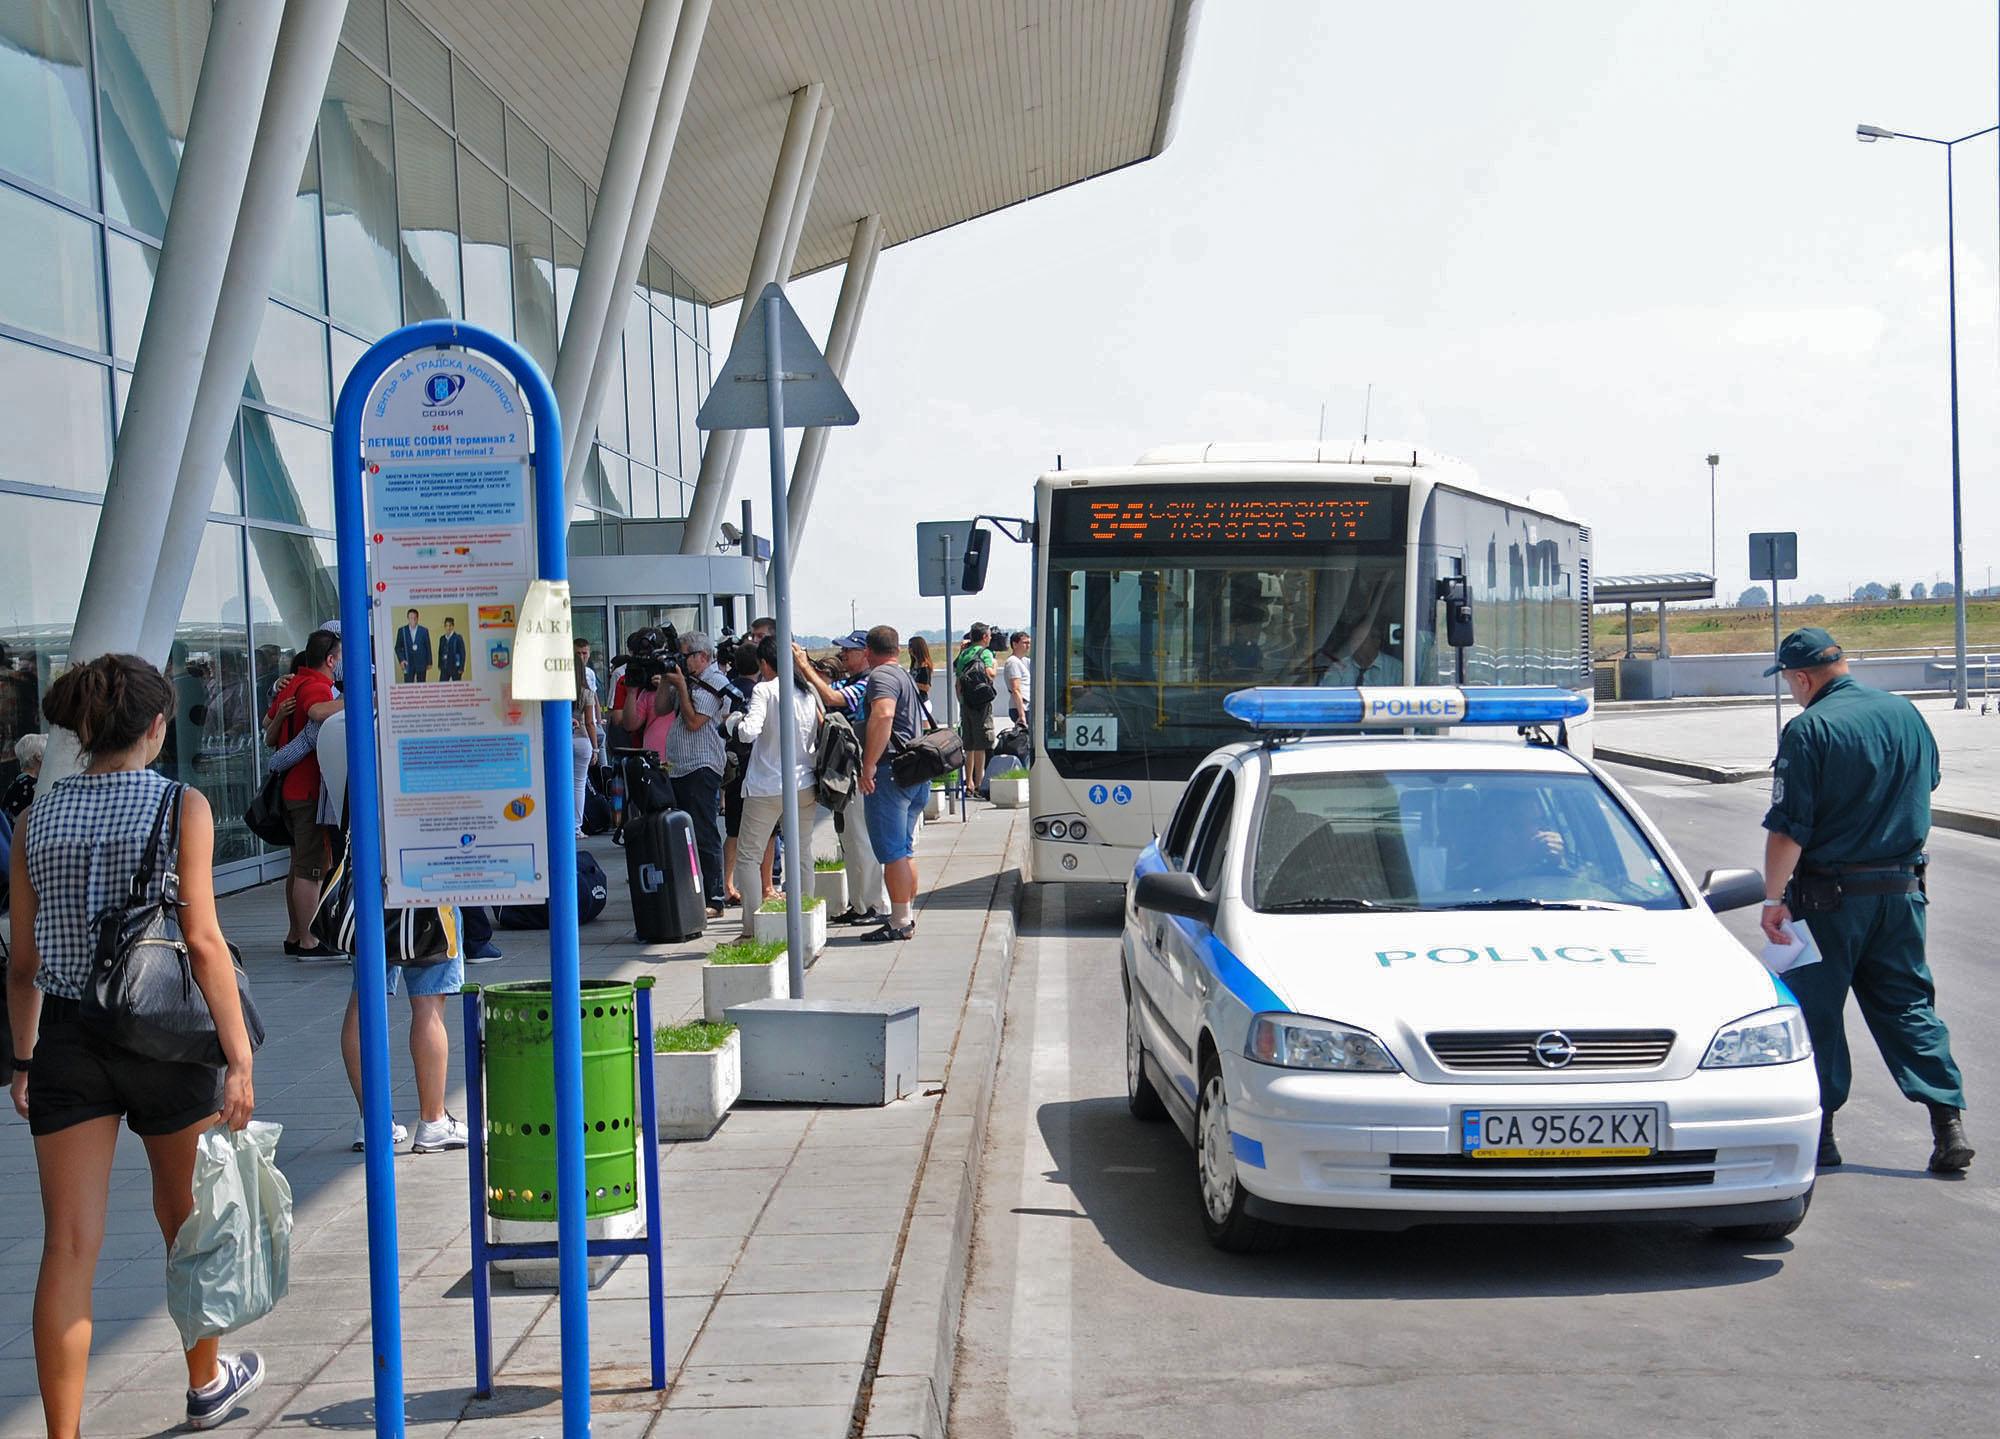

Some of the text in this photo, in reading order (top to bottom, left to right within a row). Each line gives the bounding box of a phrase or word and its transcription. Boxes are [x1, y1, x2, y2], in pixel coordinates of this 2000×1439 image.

[375, 359, 515, 418] ЦЕНТЪР ЗА ГРАДСКА МОБИЛНОСТ
[422, 409, 464, 418] СОФИЯ
[367, 433, 515, 449] ЛЕТИЩЕ СОФИЯ терминал 2
[390, 446, 495, 458] SOFIA AIRPORT terminal 2
[1372, 699, 1457, 716] POLICE
[1076, 725, 1106, 747] 84
[1375, 946, 1656, 968] POLICE
[1485, 1114, 1650, 1145] CA 9562 KX
[1466, 1135, 1479, 1145] BG
